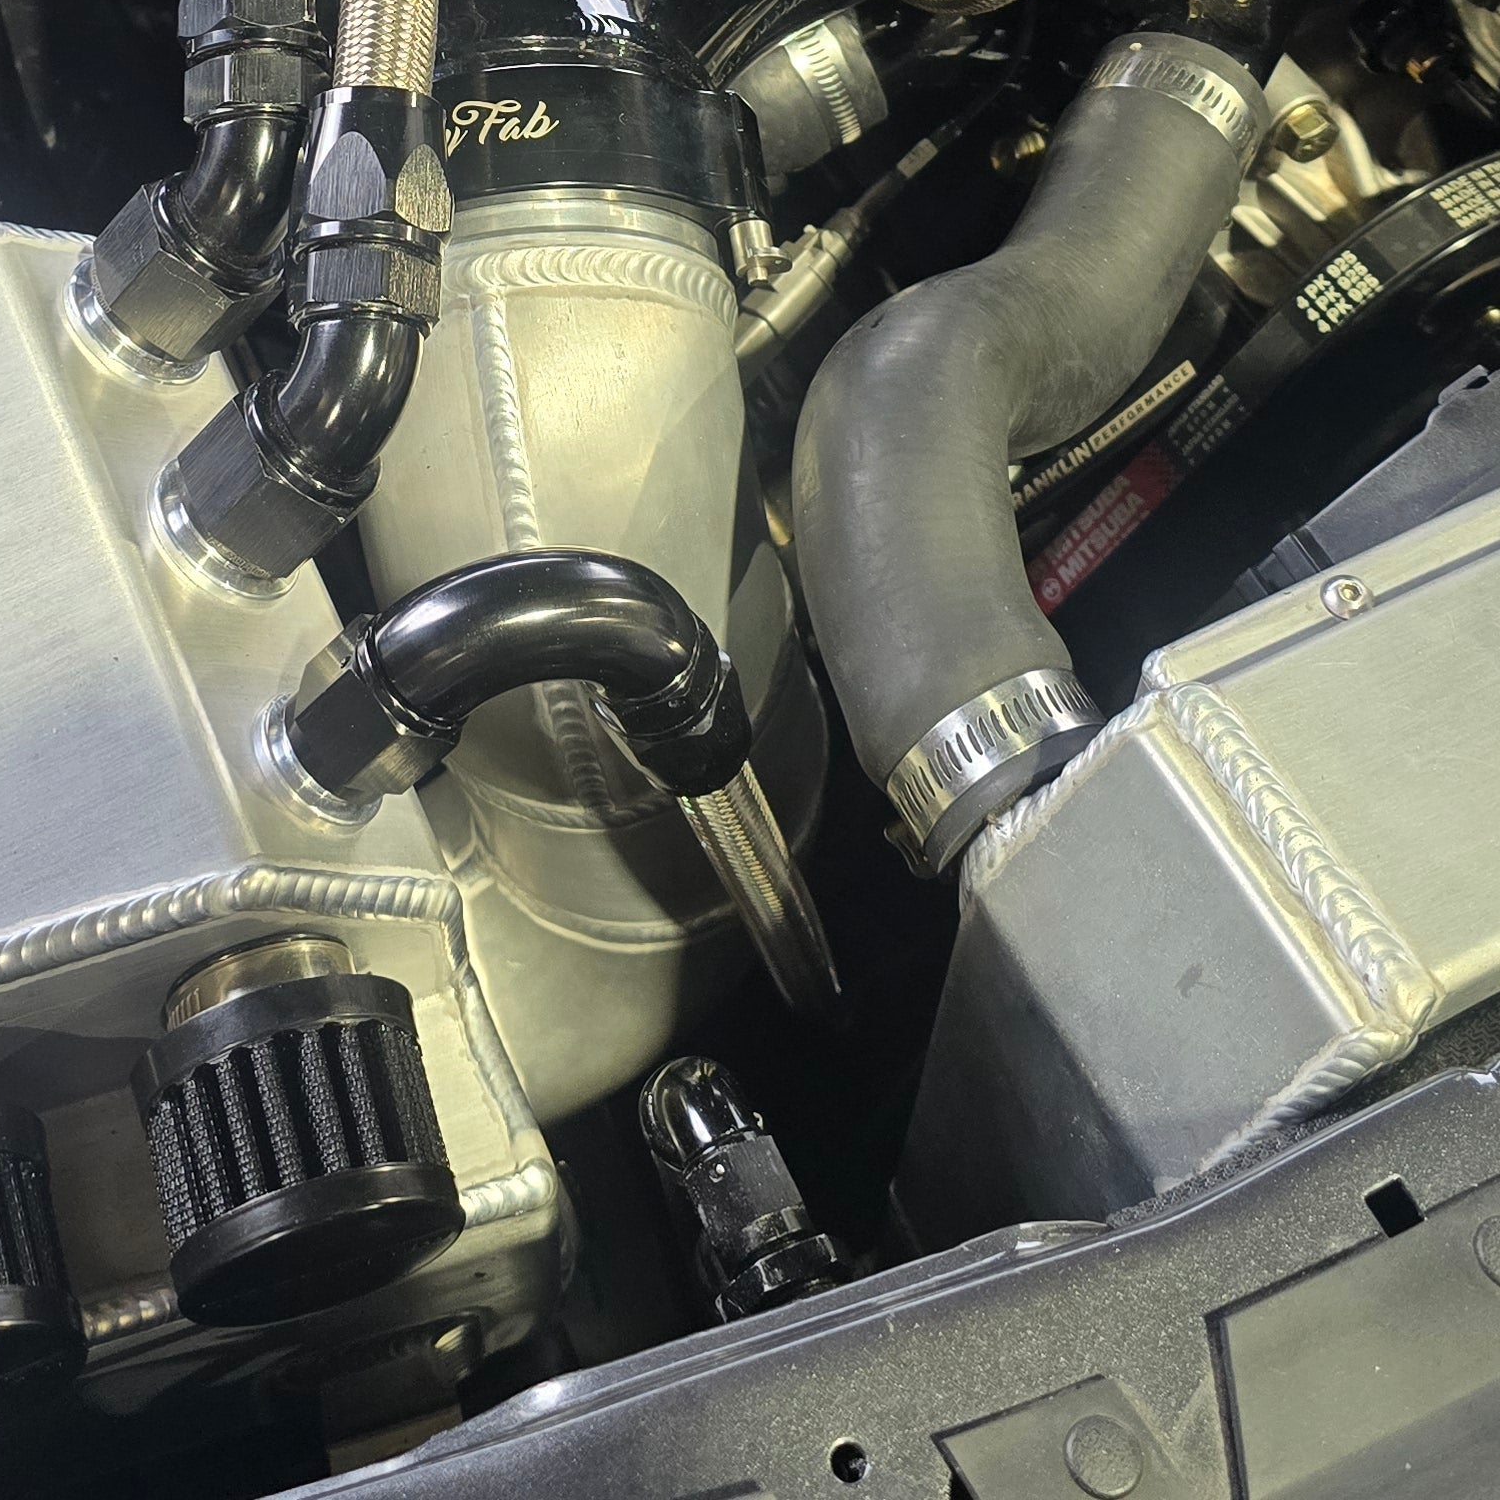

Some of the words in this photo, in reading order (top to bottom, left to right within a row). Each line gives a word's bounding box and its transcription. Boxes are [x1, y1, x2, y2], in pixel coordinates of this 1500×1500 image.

[451, 99, 560, 145] Fab
[1429, 175, 1472, 201] MADE
[1438, 184, 1481, 210] MADE
[1446, 193, 1490, 219] MADE
[1455, 202, 1500, 229] MADE
[1304, 273, 1332, 300] PK
[1315, 285, 1342, 312] PK
[1326, 297, 1353, 324] PK
[1011, 441, 1093, 511] RANKLIN
[1093, 366, 1191, 449] PERFORMANCE
[1057, 491, 1145, 586] MITSUBA
